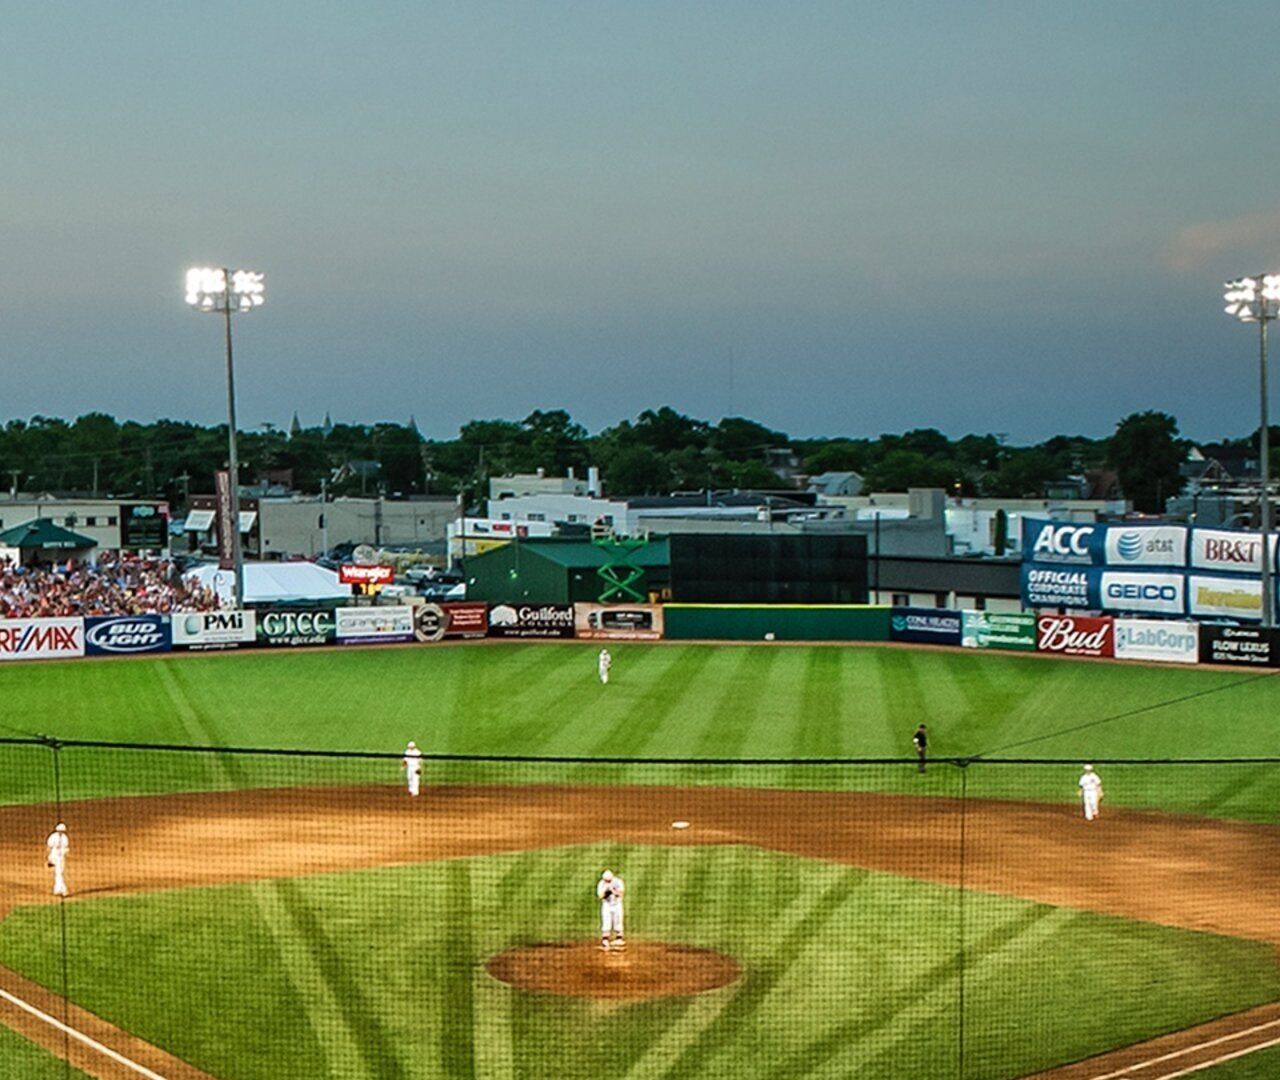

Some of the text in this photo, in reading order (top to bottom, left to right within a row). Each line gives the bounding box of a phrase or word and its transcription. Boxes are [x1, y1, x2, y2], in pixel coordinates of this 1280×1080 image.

[1033, 525, 1094, 554] ACC
[1205, 538, 1260, 563] BB&T
[342, 566, 390, 583] Wrangler
[1028, 569, 1088, 584] OFFICIAL
[1028, 583, 1088, 595] CORPORATE
[1108, 584, 1177, 600] GEICO
[204, 613, 243, 630] PMi
[519, 606, 573, 622] Guilford
[109, 623, 157, 634] BUD
[263, 612, 330, 636] GTCC
[99, 633, 163, 645] LIGHT
[1038, 618, 1111, 650] Bud
[1127, 628, 1196, 652] LabCorp
